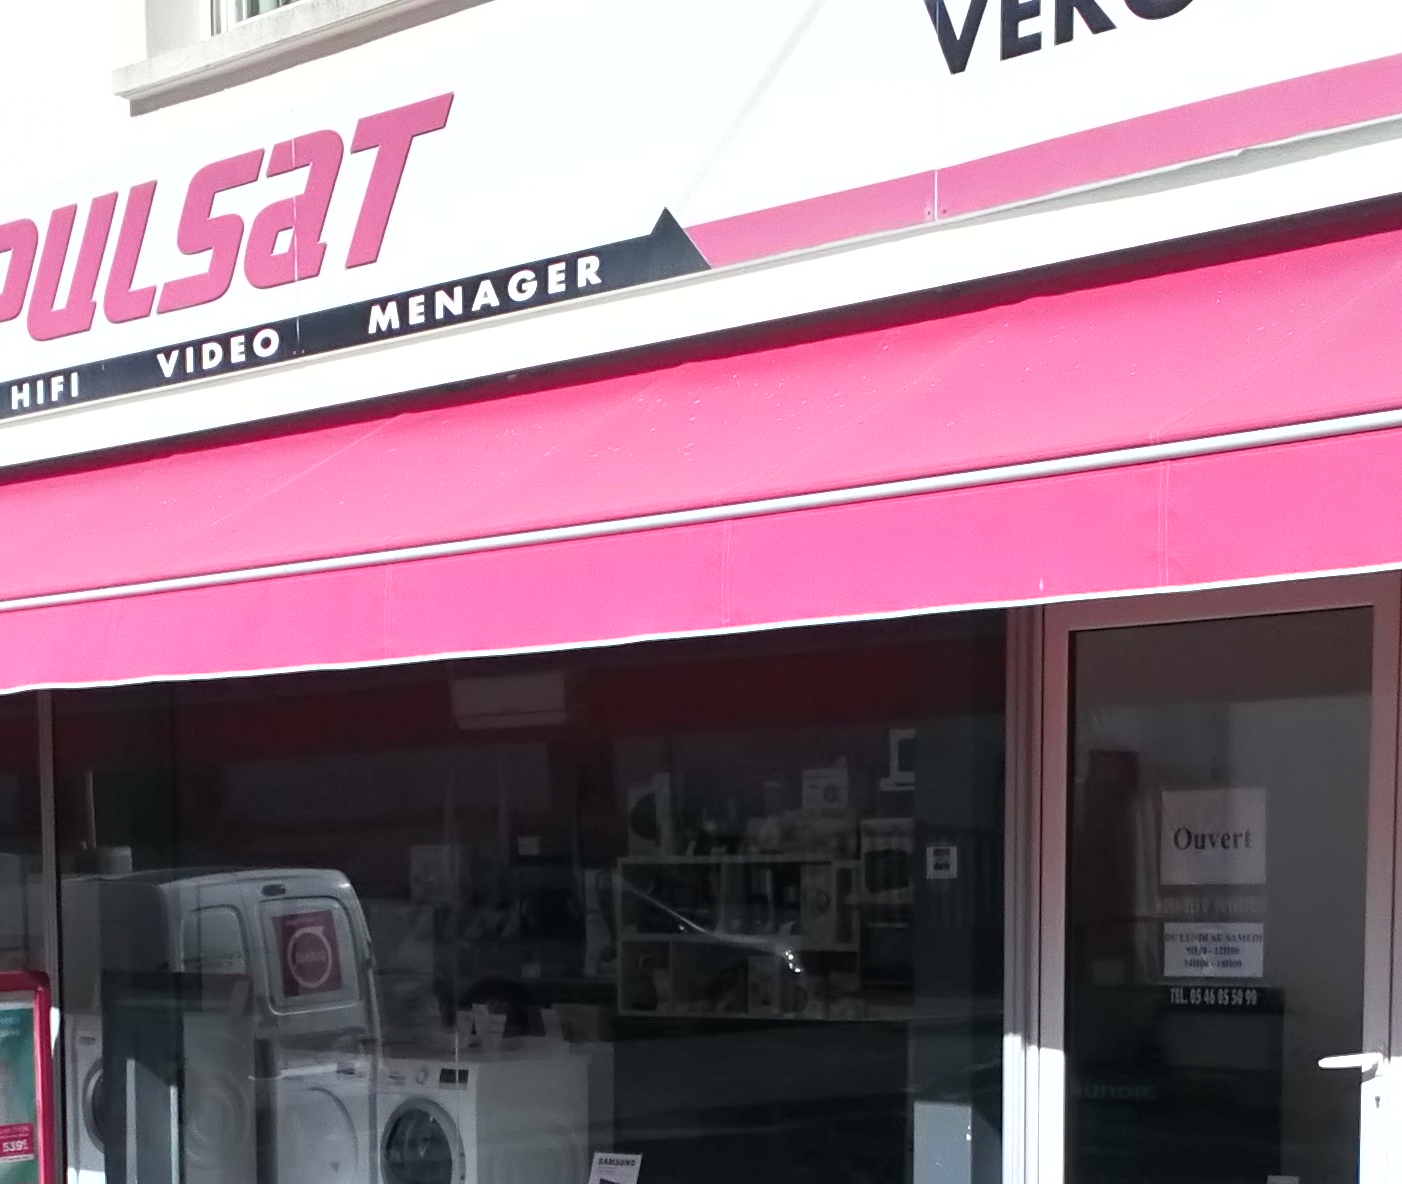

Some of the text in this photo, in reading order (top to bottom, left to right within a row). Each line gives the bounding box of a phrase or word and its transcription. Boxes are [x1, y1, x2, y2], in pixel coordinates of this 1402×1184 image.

[923, 0, 1195, 75] VER
[10, 371, 80, 411] HIFI
[157, 328, 281, 379] VIDEO
[367, 254, 603, 335] MENAGER
[1172, 826, 1252, 851] Ouvert
[598, 1157, 636, 1167] SAMSUNG
